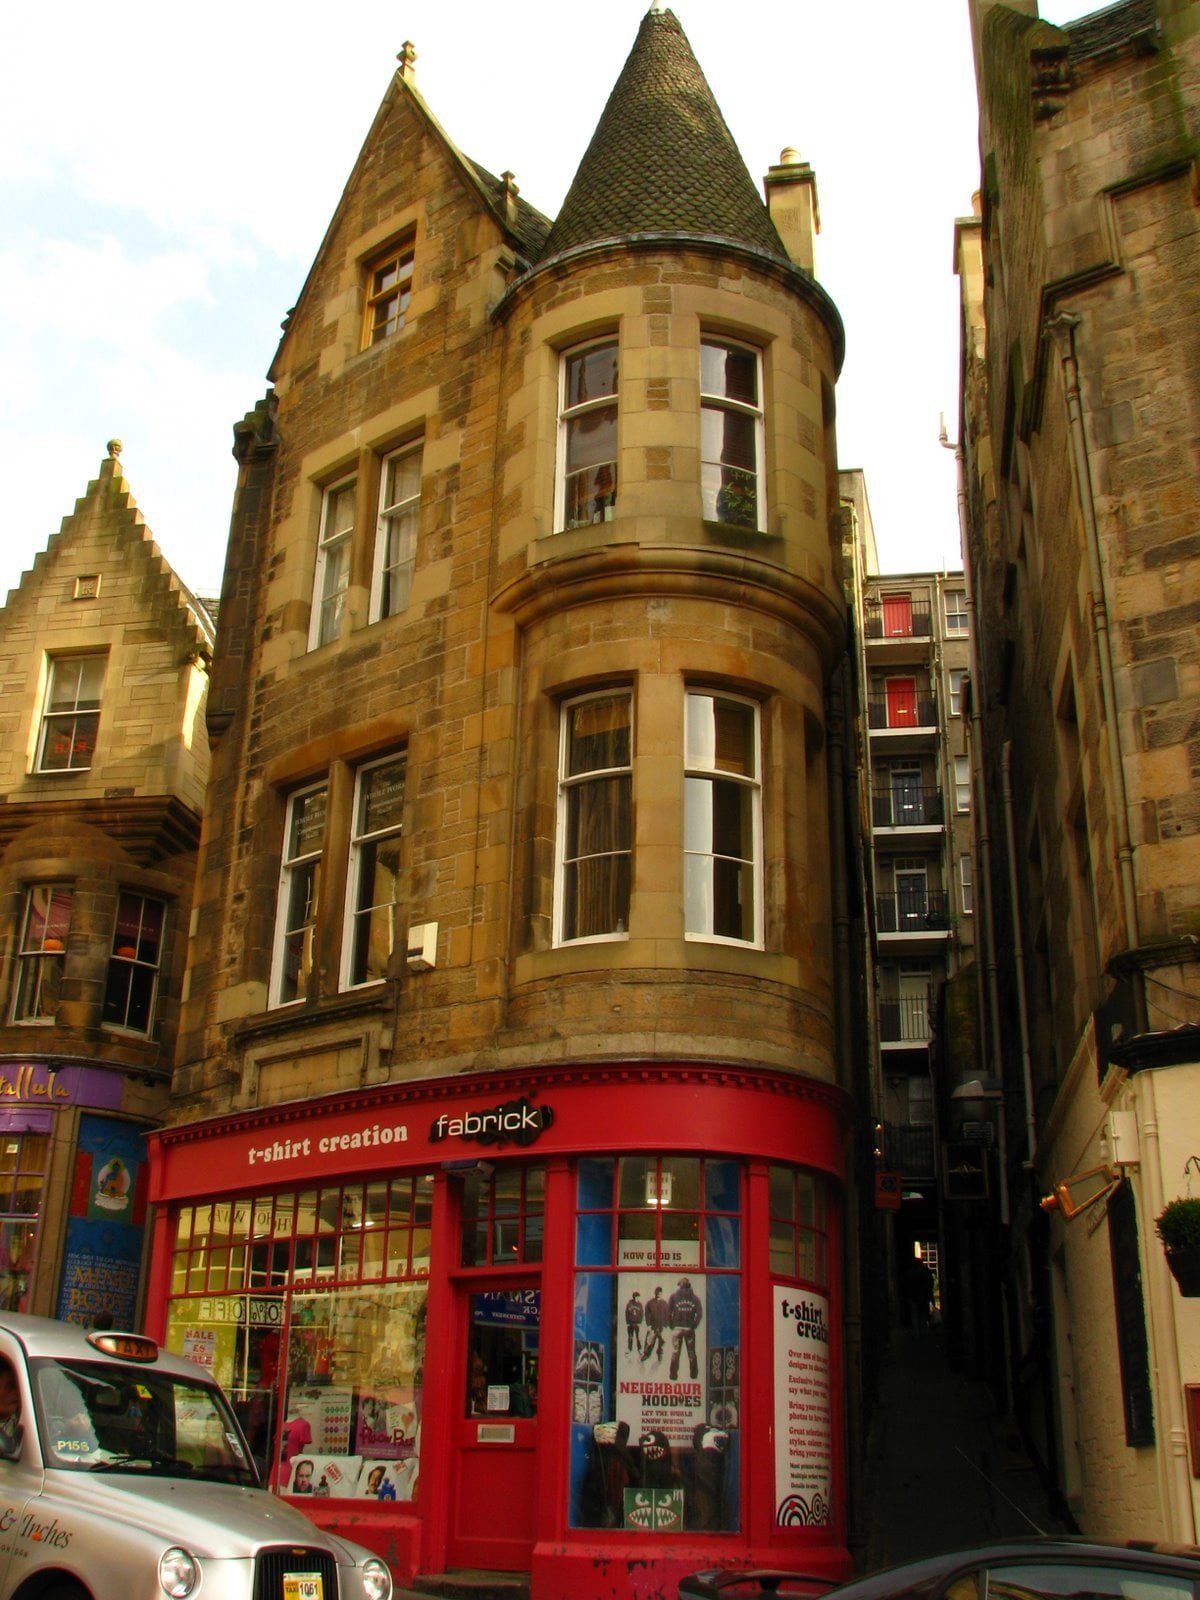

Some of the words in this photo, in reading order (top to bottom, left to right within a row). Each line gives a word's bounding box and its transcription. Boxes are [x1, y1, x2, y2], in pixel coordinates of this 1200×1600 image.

[436, 1105, 539, 1137] fabrick
[248, 1138, 311, 1165] t-shirt
[319, 1125, 408, 1153] creation
[623, 1252, 645, 1260] HOW
[672, 1253, 682, 1261] IS
[781, 1299, 823, 1326] t-shirt
[620, 1382, 702, 1395] NEIGHBOUR
[789, 1427, 805, 1435] Great
[0, 1508, 16, 1532] &
[300, 1583, 319, 1596] 1061
